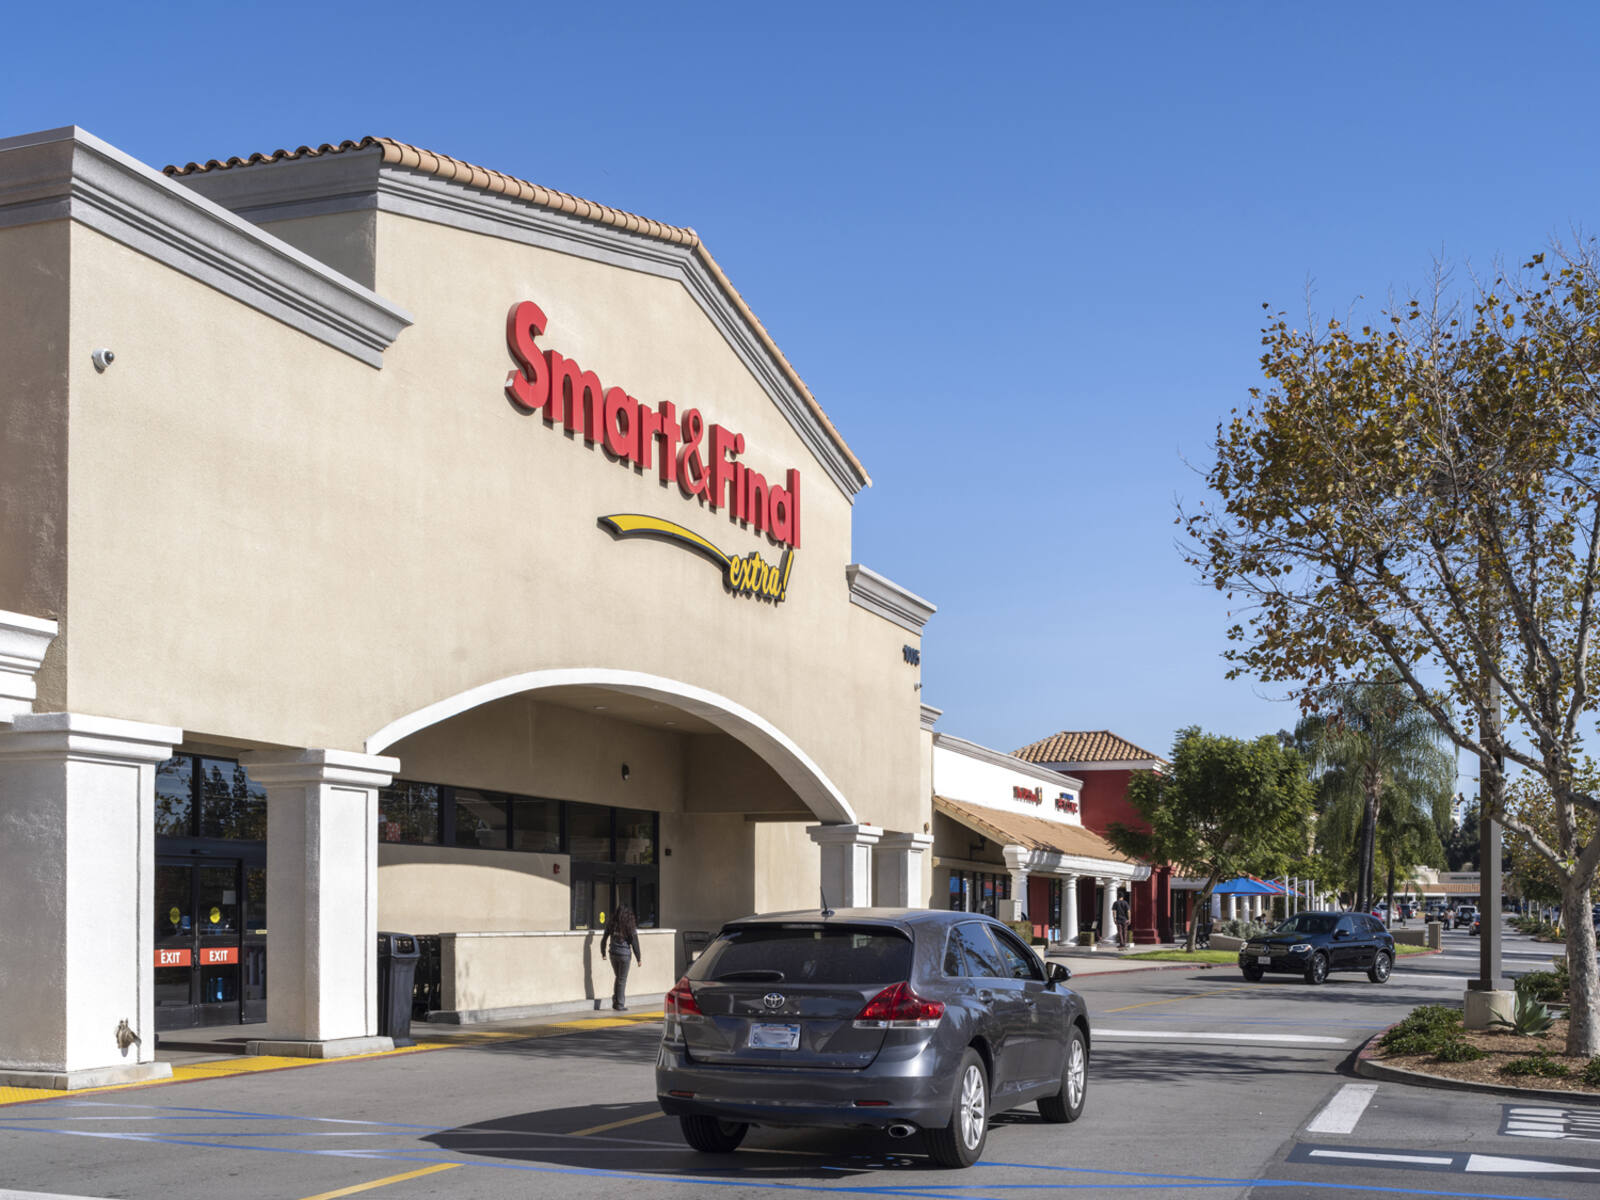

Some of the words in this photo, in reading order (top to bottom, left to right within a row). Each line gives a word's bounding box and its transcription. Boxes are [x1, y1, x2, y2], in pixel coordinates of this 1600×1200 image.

[729, 549, 794, 602] extra!
[161, 952, 181, 964] EXIT
[209, 950, 228, 962] EXIT
